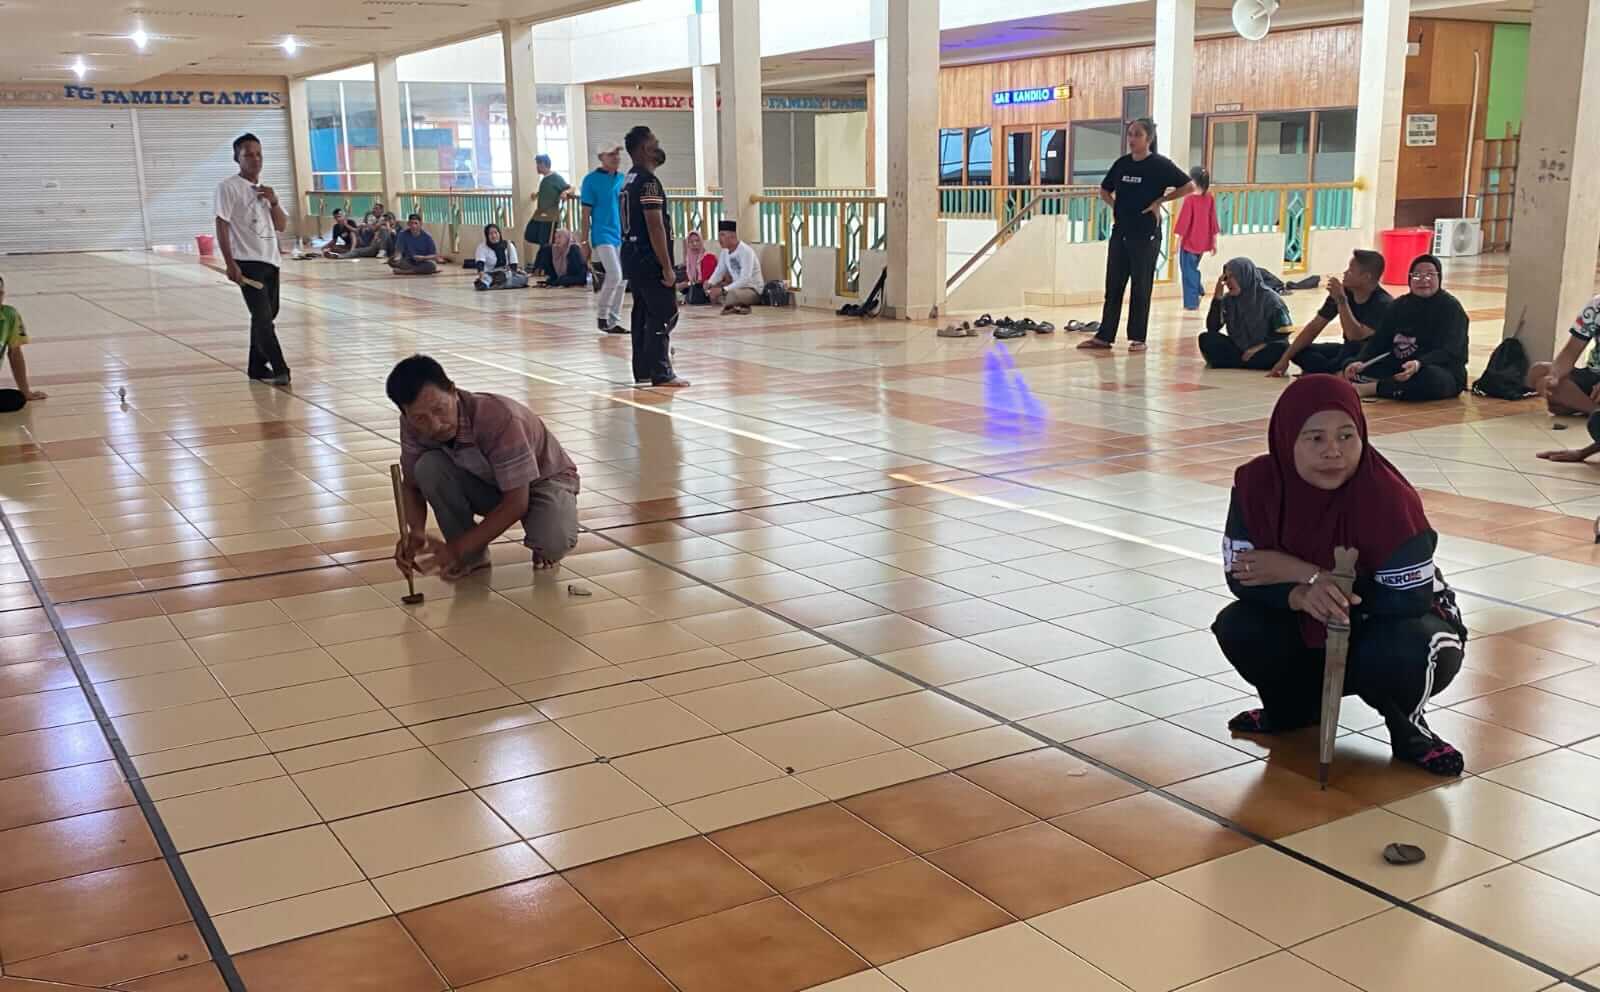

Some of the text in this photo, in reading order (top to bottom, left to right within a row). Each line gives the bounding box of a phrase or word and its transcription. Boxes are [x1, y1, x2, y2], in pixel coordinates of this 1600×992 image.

[64, 85, 95, 100] FG
[101, 90, 194, 105] FAMILY
[199, 91, 281, 105] GAMES
[620, 95, 685, 108] FAMILY
